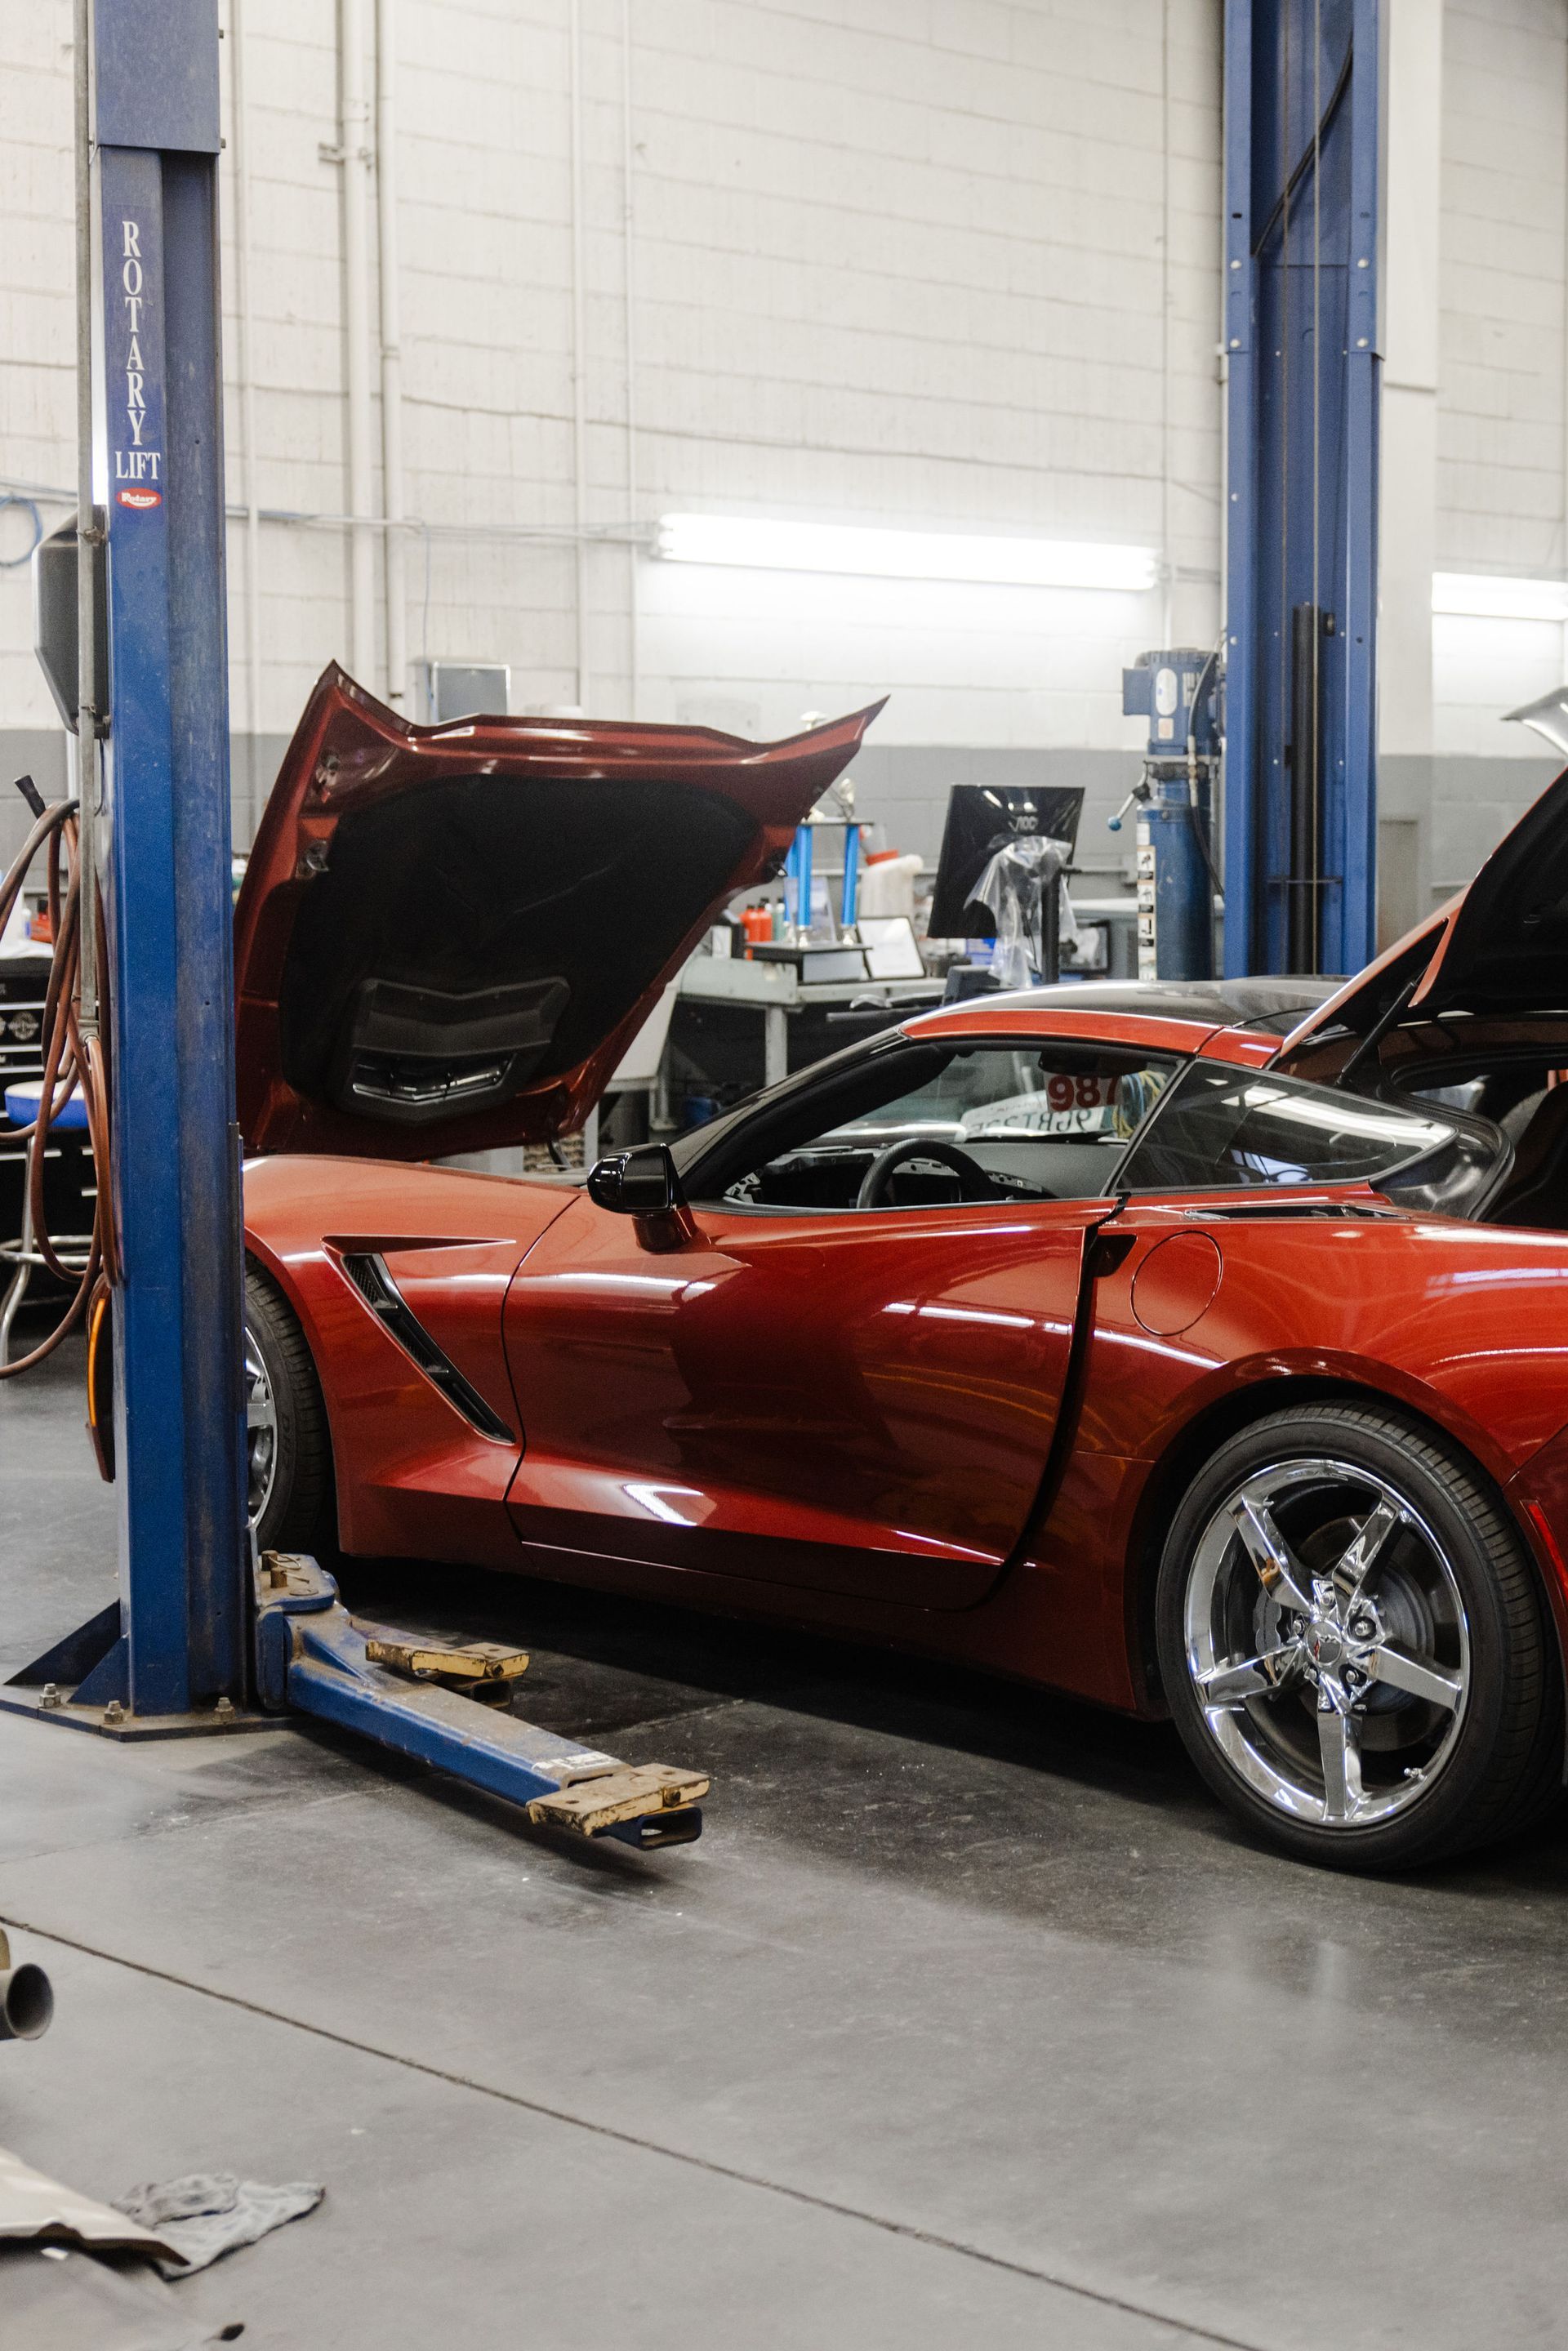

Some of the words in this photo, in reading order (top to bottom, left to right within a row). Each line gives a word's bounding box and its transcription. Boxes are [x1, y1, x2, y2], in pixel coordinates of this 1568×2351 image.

[122, 220, 145, 445] ROTARY
[115, 451, 160, 479] LIFT
[122, 492, 157, 506] Rotary
[1048, 1075, 1119, 1111] 987
